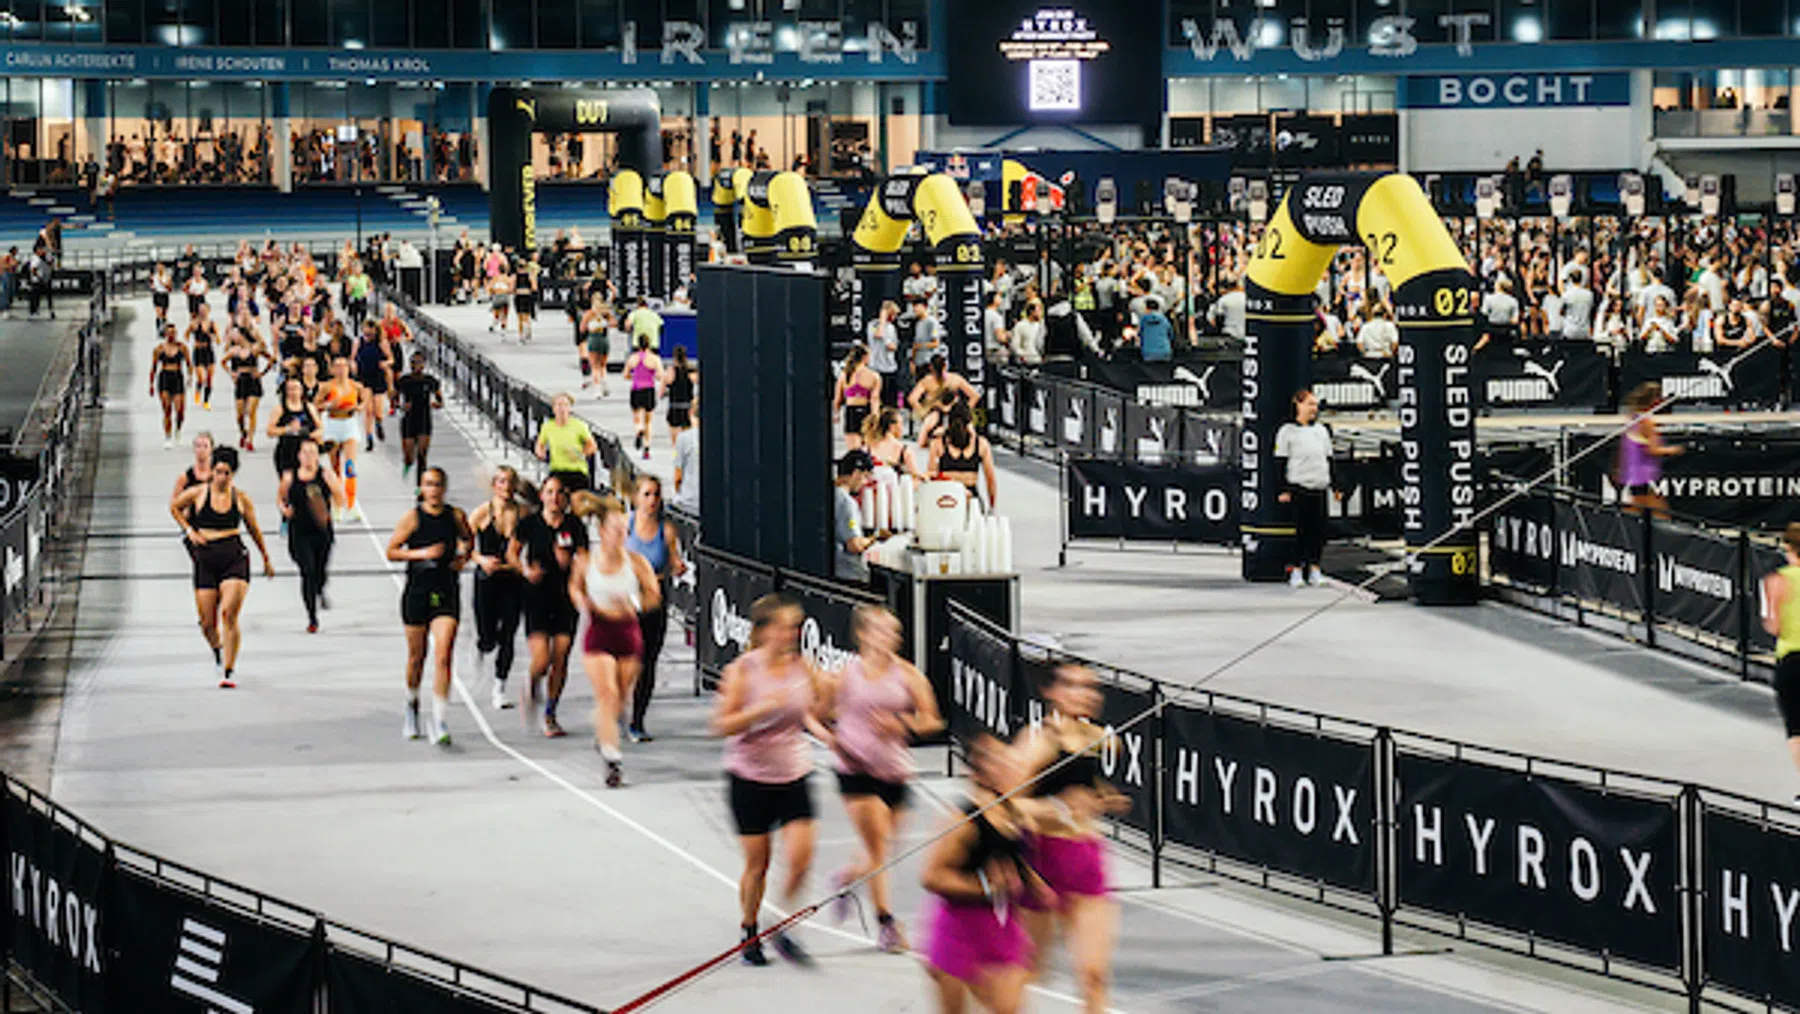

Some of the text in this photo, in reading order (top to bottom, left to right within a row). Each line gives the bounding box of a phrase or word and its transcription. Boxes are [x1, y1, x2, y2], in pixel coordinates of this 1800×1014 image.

[216, 56, 286, 71] SCHOUTEN
[328, 56, 431, 72] THOMAS KROL
[1438, 76, 1594, 105] BOCHT
[1303, 186, 1346, 209] SLED
[963, 280, 982, 335] PULL
[1433, 287, 1470, 316] 02
[1242, 336, 1258, 512] SLED PUSH
[1487, 379, 1555, 402] PUMA
[1445, 344, 1475, 530] SLED PUSH
[1401, 440, 1422, 530] PUSH
[1028, 699, 1142, 787] HOX
[1175, 748, 1361, 845] HYROX
[1414, 803, 1658, 915] HYROX
[12, 851, 101, 974] HYROX
[1721, 869, 1800, 953] HY
